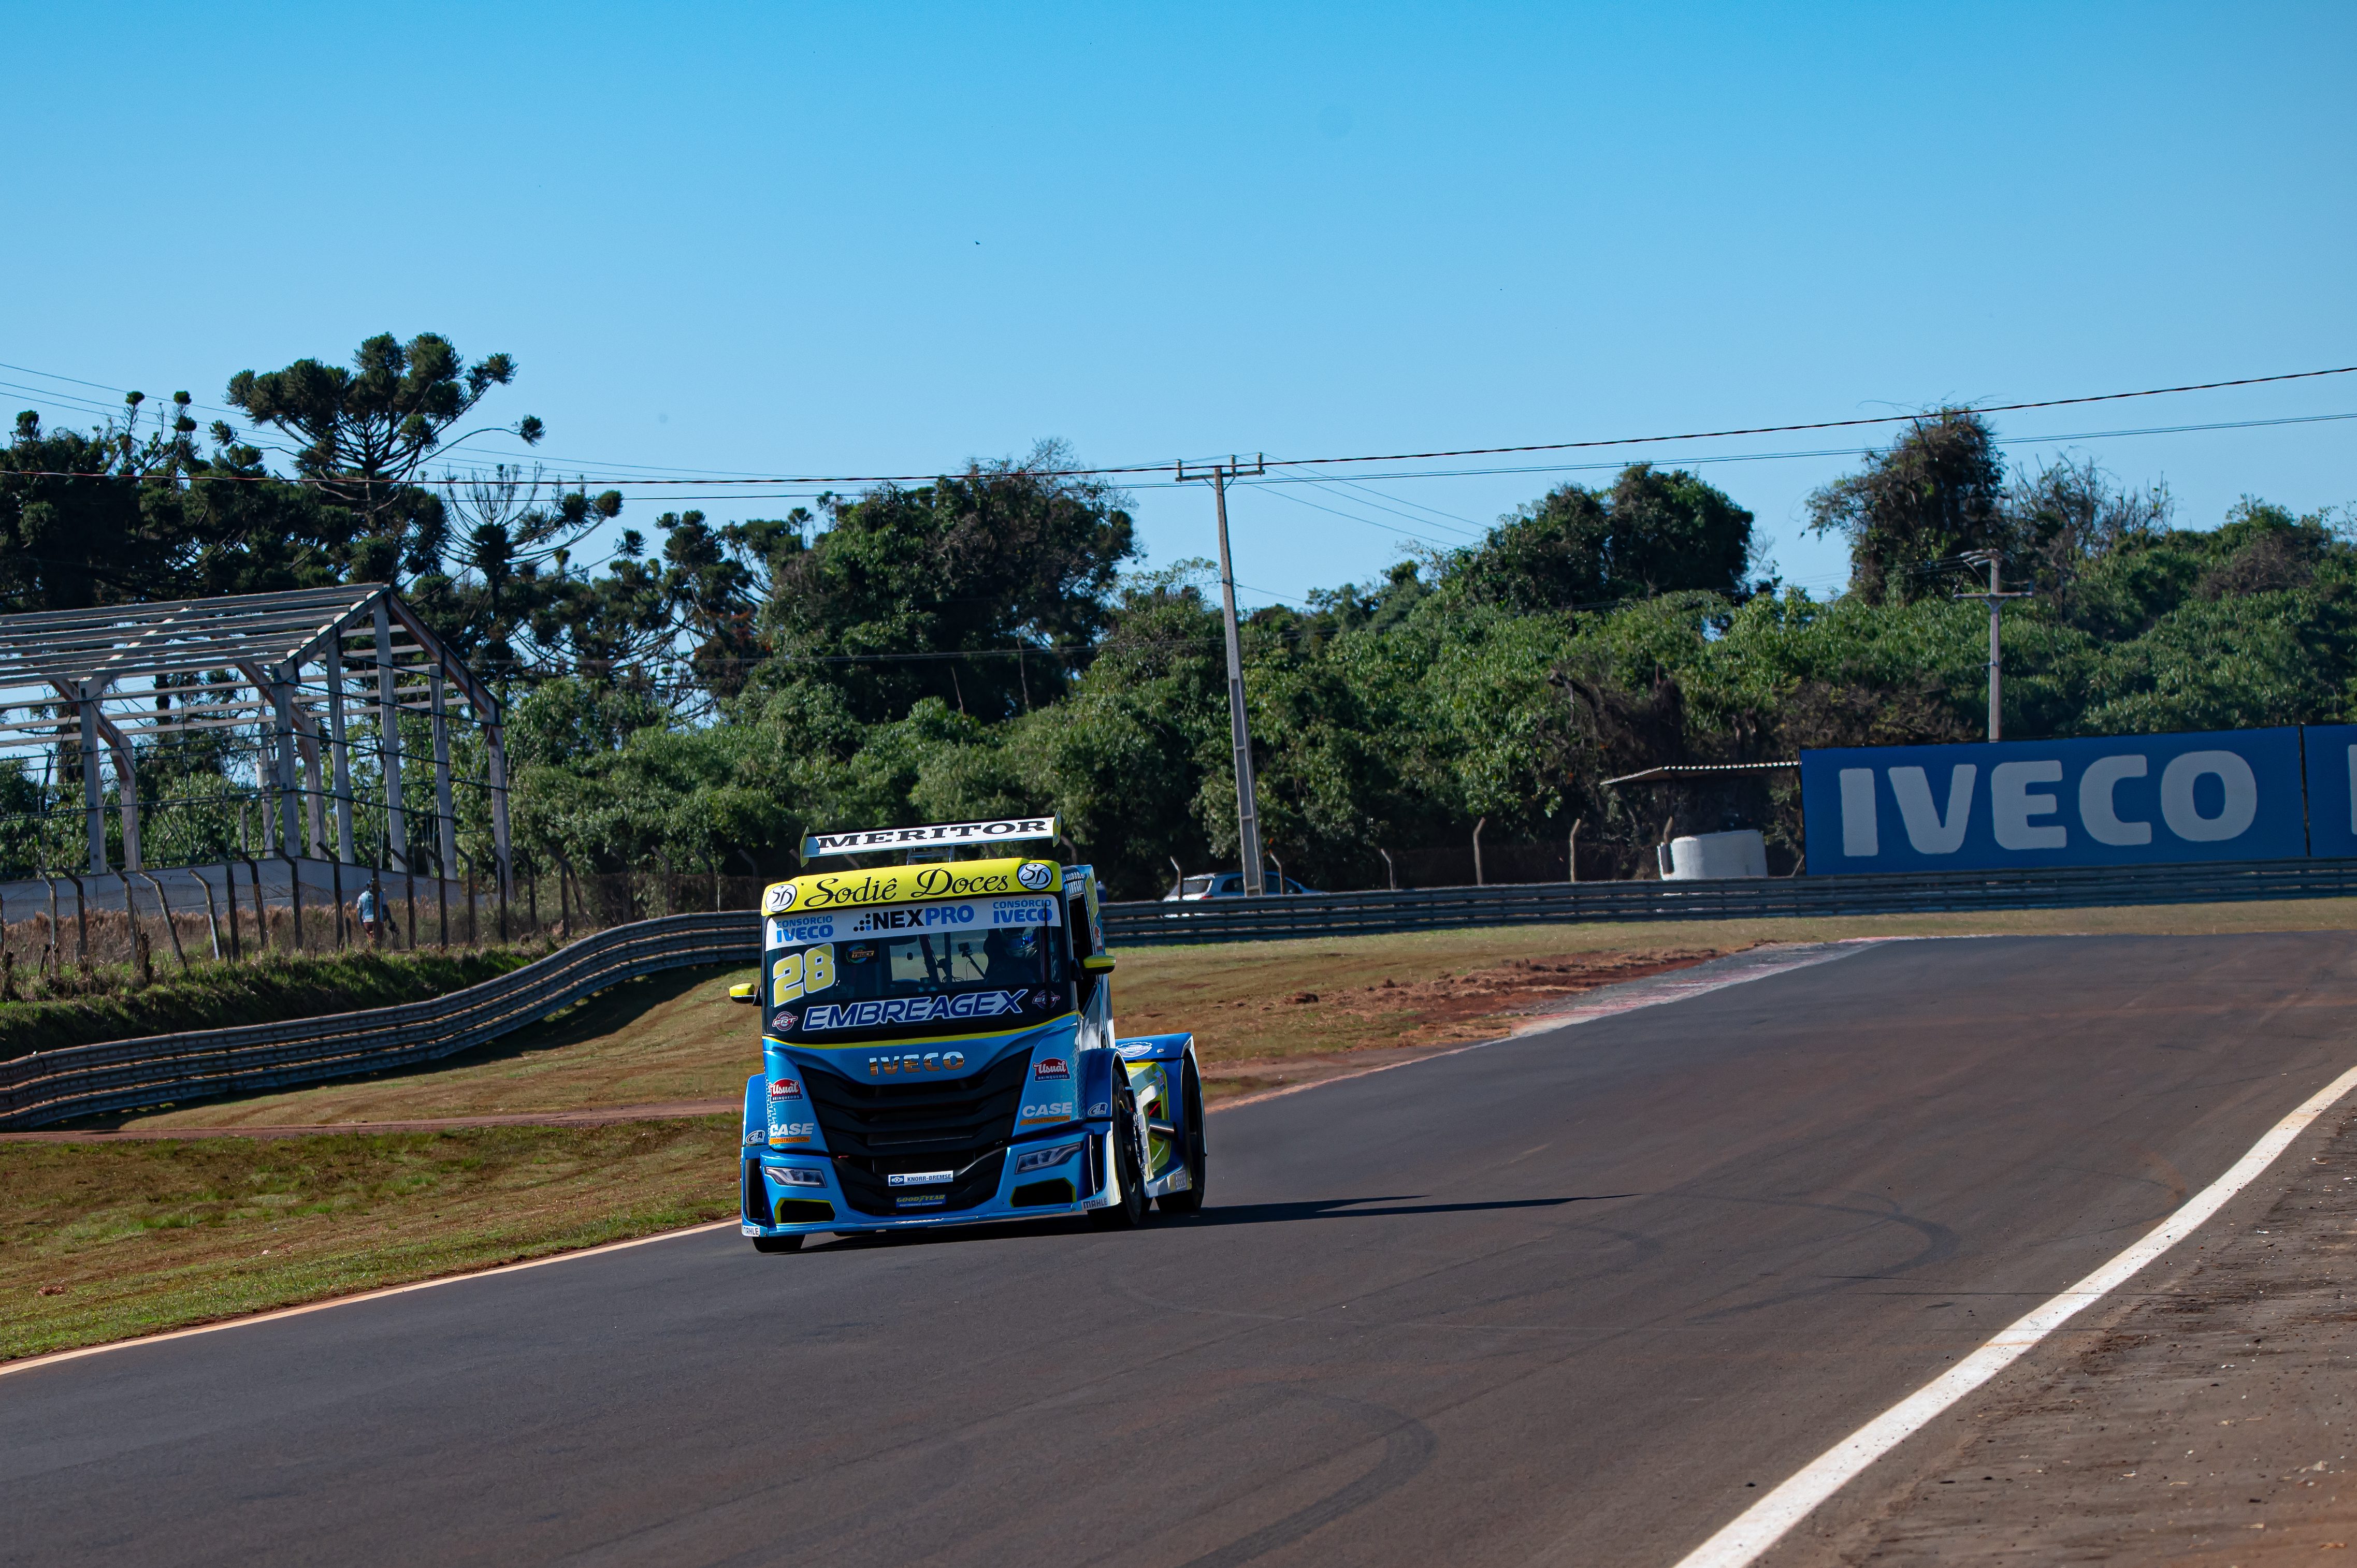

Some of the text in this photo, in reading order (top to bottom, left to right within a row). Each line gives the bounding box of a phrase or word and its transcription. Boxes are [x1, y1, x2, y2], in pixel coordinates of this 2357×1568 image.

[1839, 750, 2258, 857] IVECO
[816, 821, 1047, 849] MERITOR
[804, 867, 1008, 907] Sodiê Doces
[993, 899, 1052, 909] CONSÓRCIO
[777, 915, 833, 927] CONSÓRCIO
[873, 905, 975, 930] NEXPRO
[993, 908, 1053, 923] IVECO
[777, 924, 834, 942] IVECO
[773, 942, 835, 1008] 28
[803, 989, 1028, 1030] EMBREAGEX
[773, 1017, 797, 1026] ERT
[870, 1052, 964, 1076] IVECO
[1034, 1061, 1066, 1074] Usual
[771, 1081, 799, 1095] Usual
[1022, 1102, 1073, 1117] CASE
[770, 1123, 814, 1136] CASE
[1083, 1198, 1108, 1209] MAHLE
[743, 1227, 759, 1236] MAHLE
